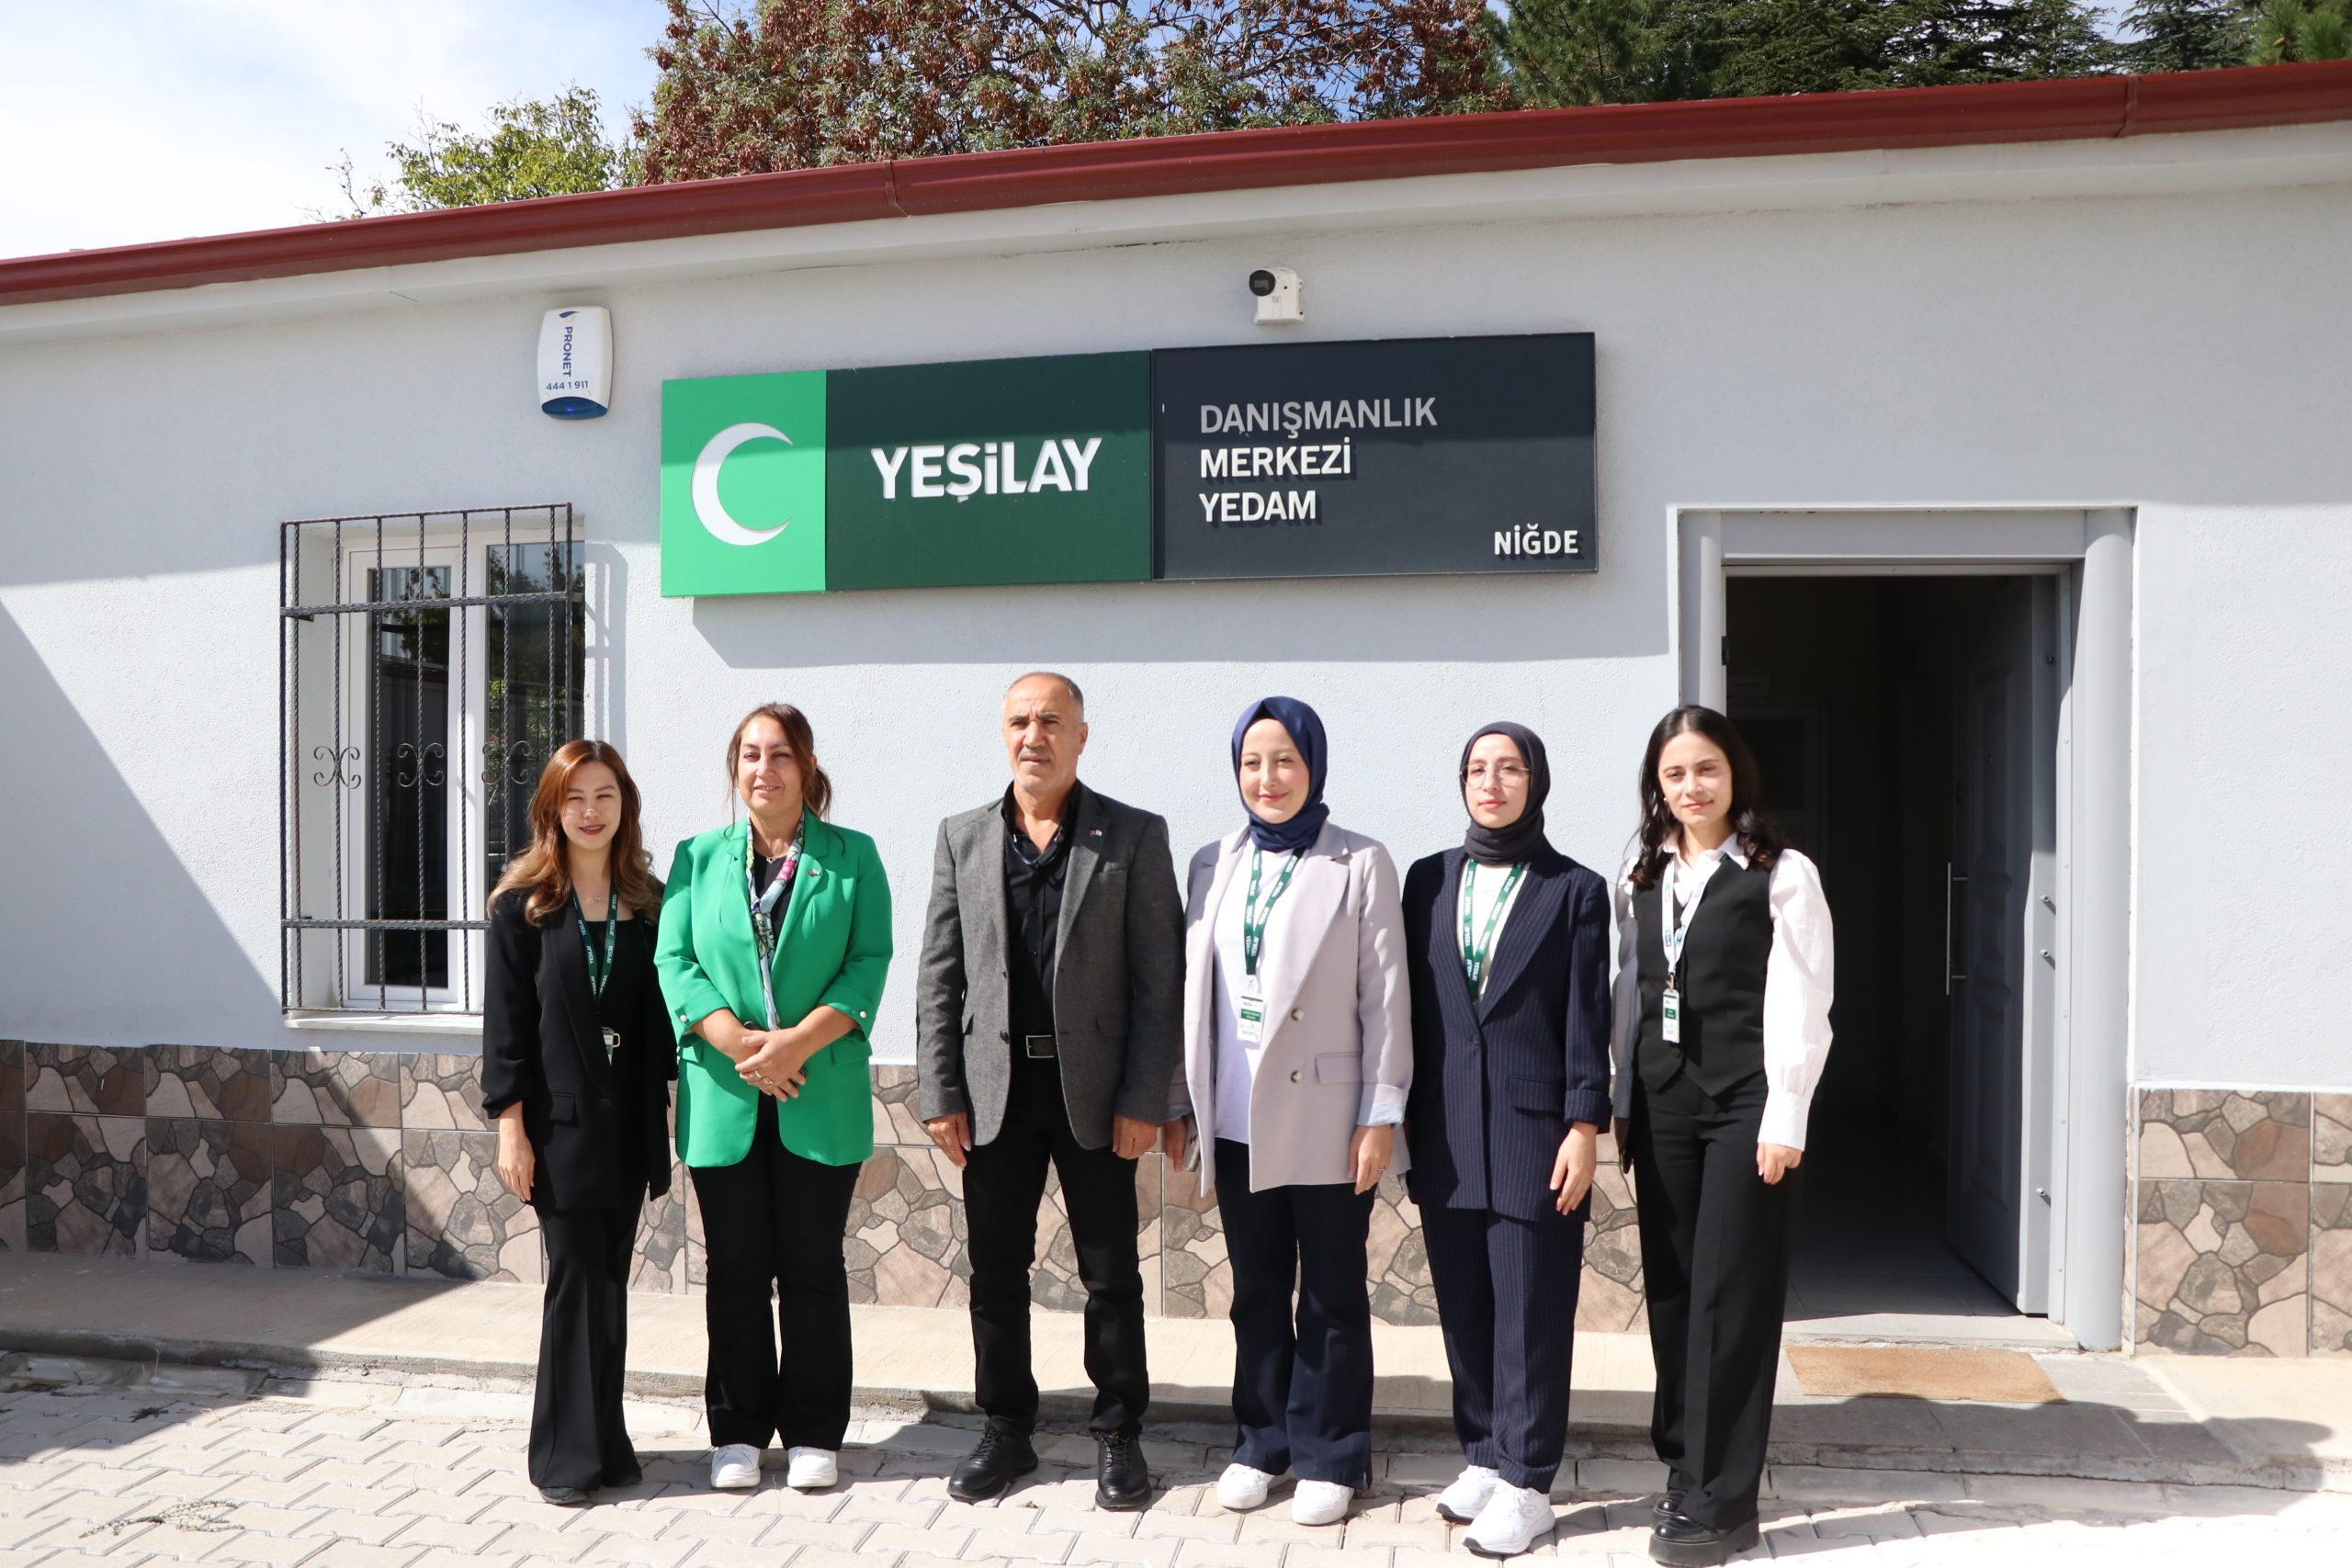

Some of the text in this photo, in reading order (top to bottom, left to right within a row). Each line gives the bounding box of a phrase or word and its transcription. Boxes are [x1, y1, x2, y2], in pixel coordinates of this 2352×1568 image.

[563, 326, 573, 378] PRONET
[546, 380, 589, 390] 444 1 911
[1200, 397, 1438, 439] DANIŞMANLIK
[1200, 436, 1351, 478] MERKEZİ
[1199, 490, 1317, 522] YEDAM
[1494, 523, 1578, 555] NİĞDE
